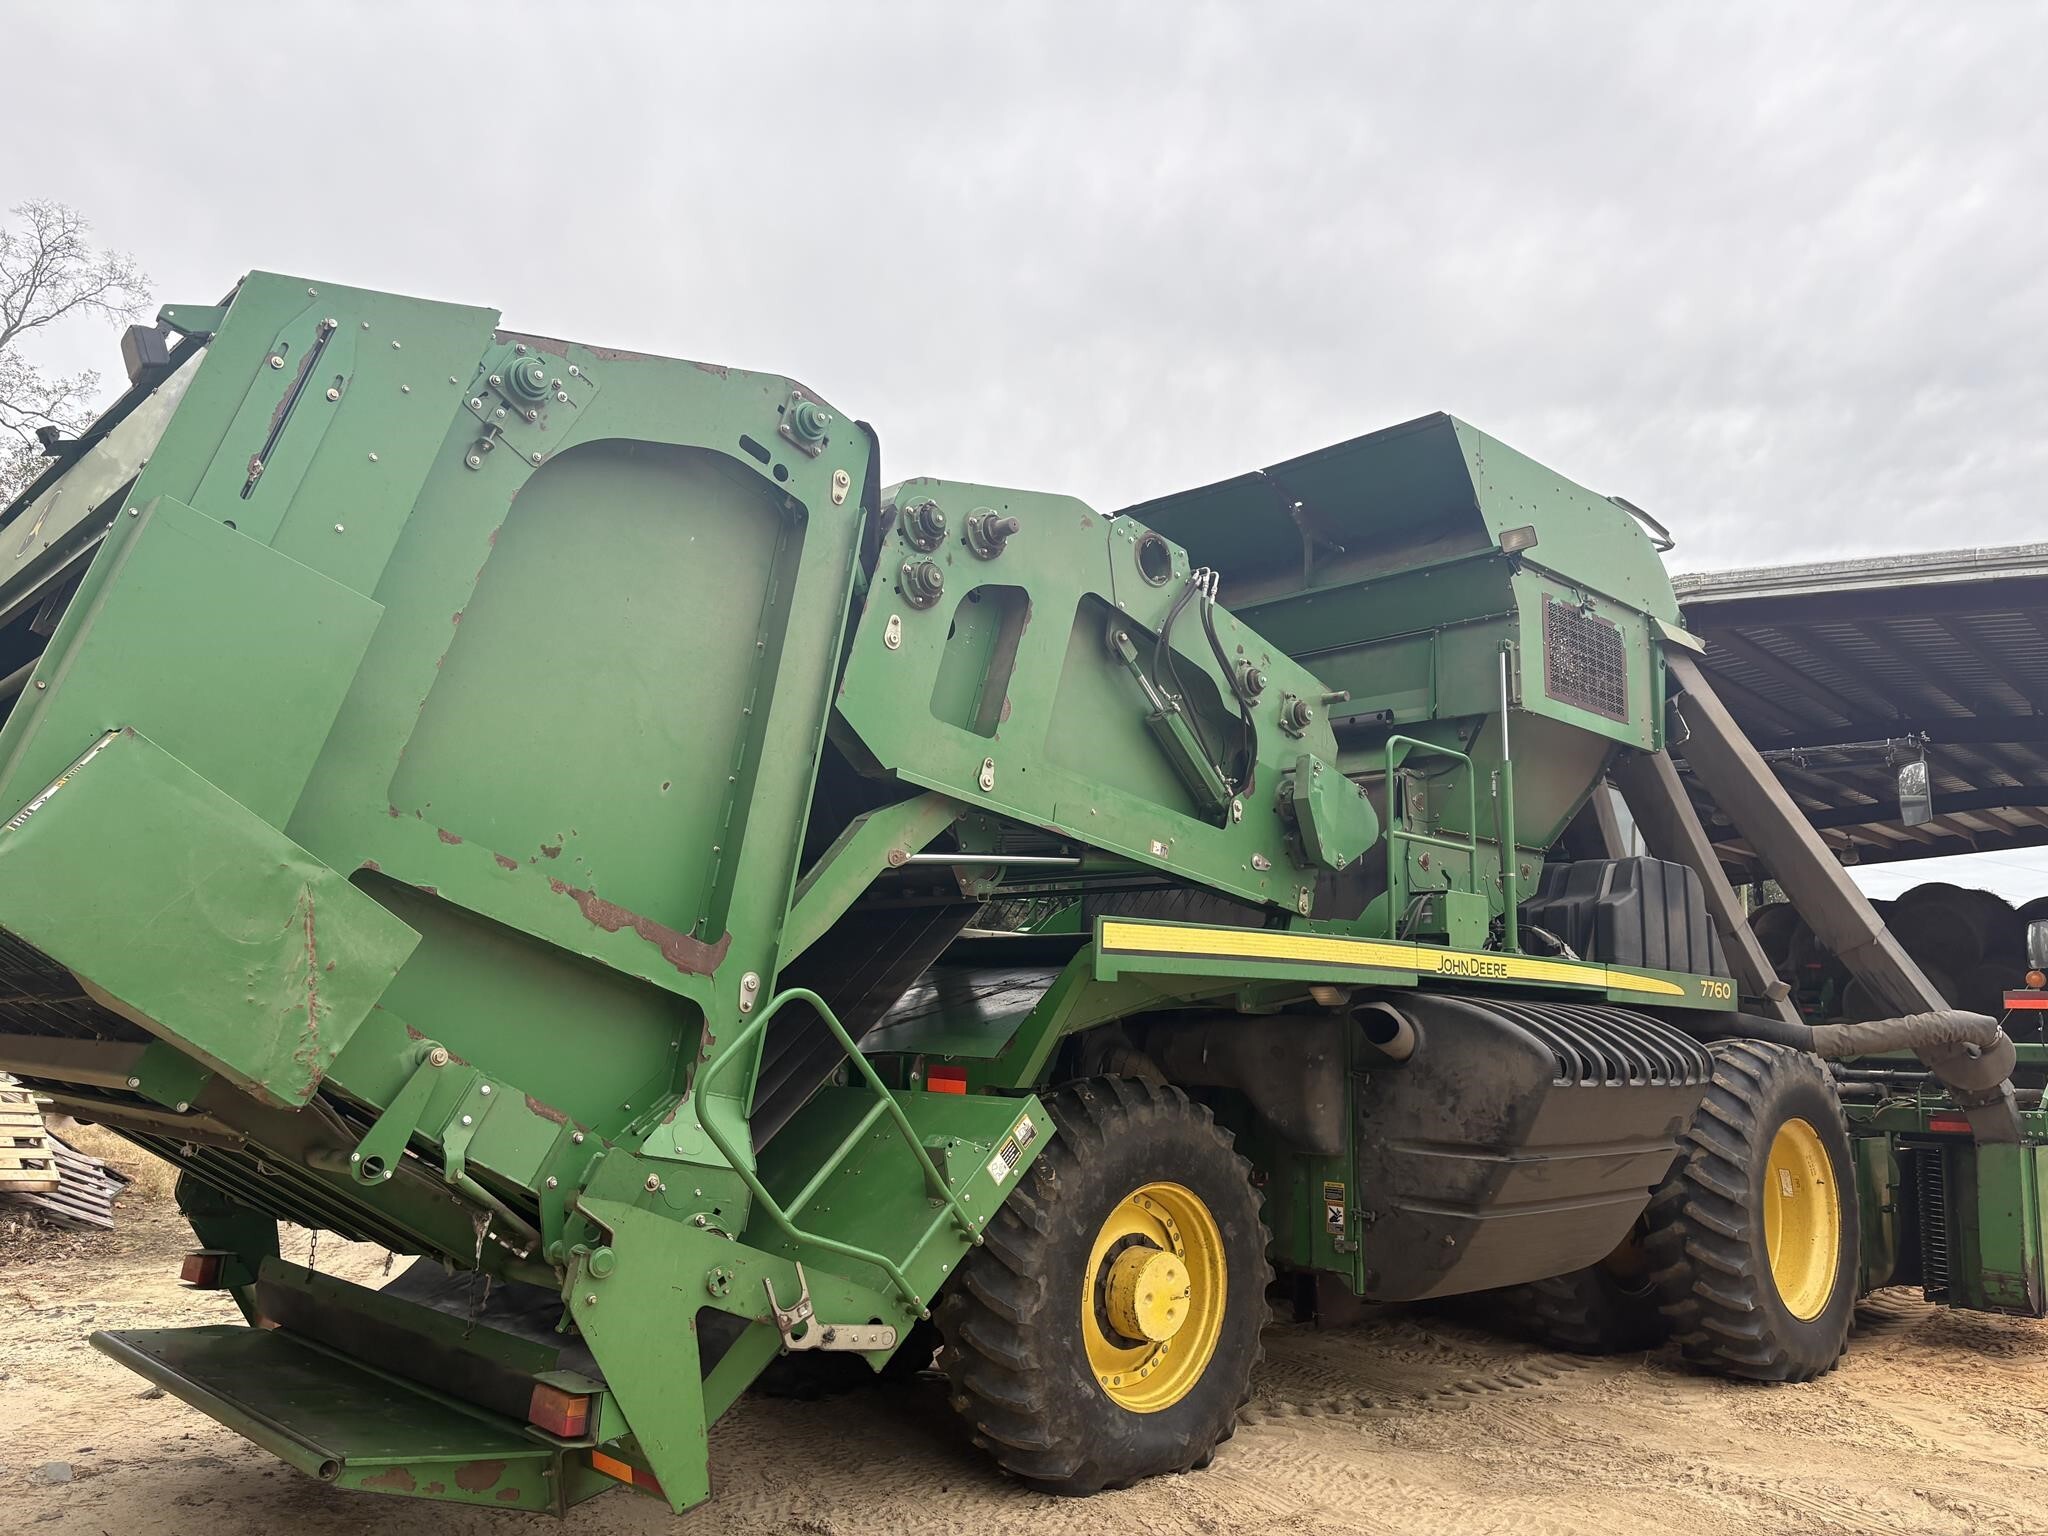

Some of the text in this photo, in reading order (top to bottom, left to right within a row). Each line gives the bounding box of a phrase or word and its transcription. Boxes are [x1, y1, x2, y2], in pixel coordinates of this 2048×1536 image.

[1437, 954, 1508, 977] JOHN DEERE
[1700, 979, 1731, 1000] 7760
